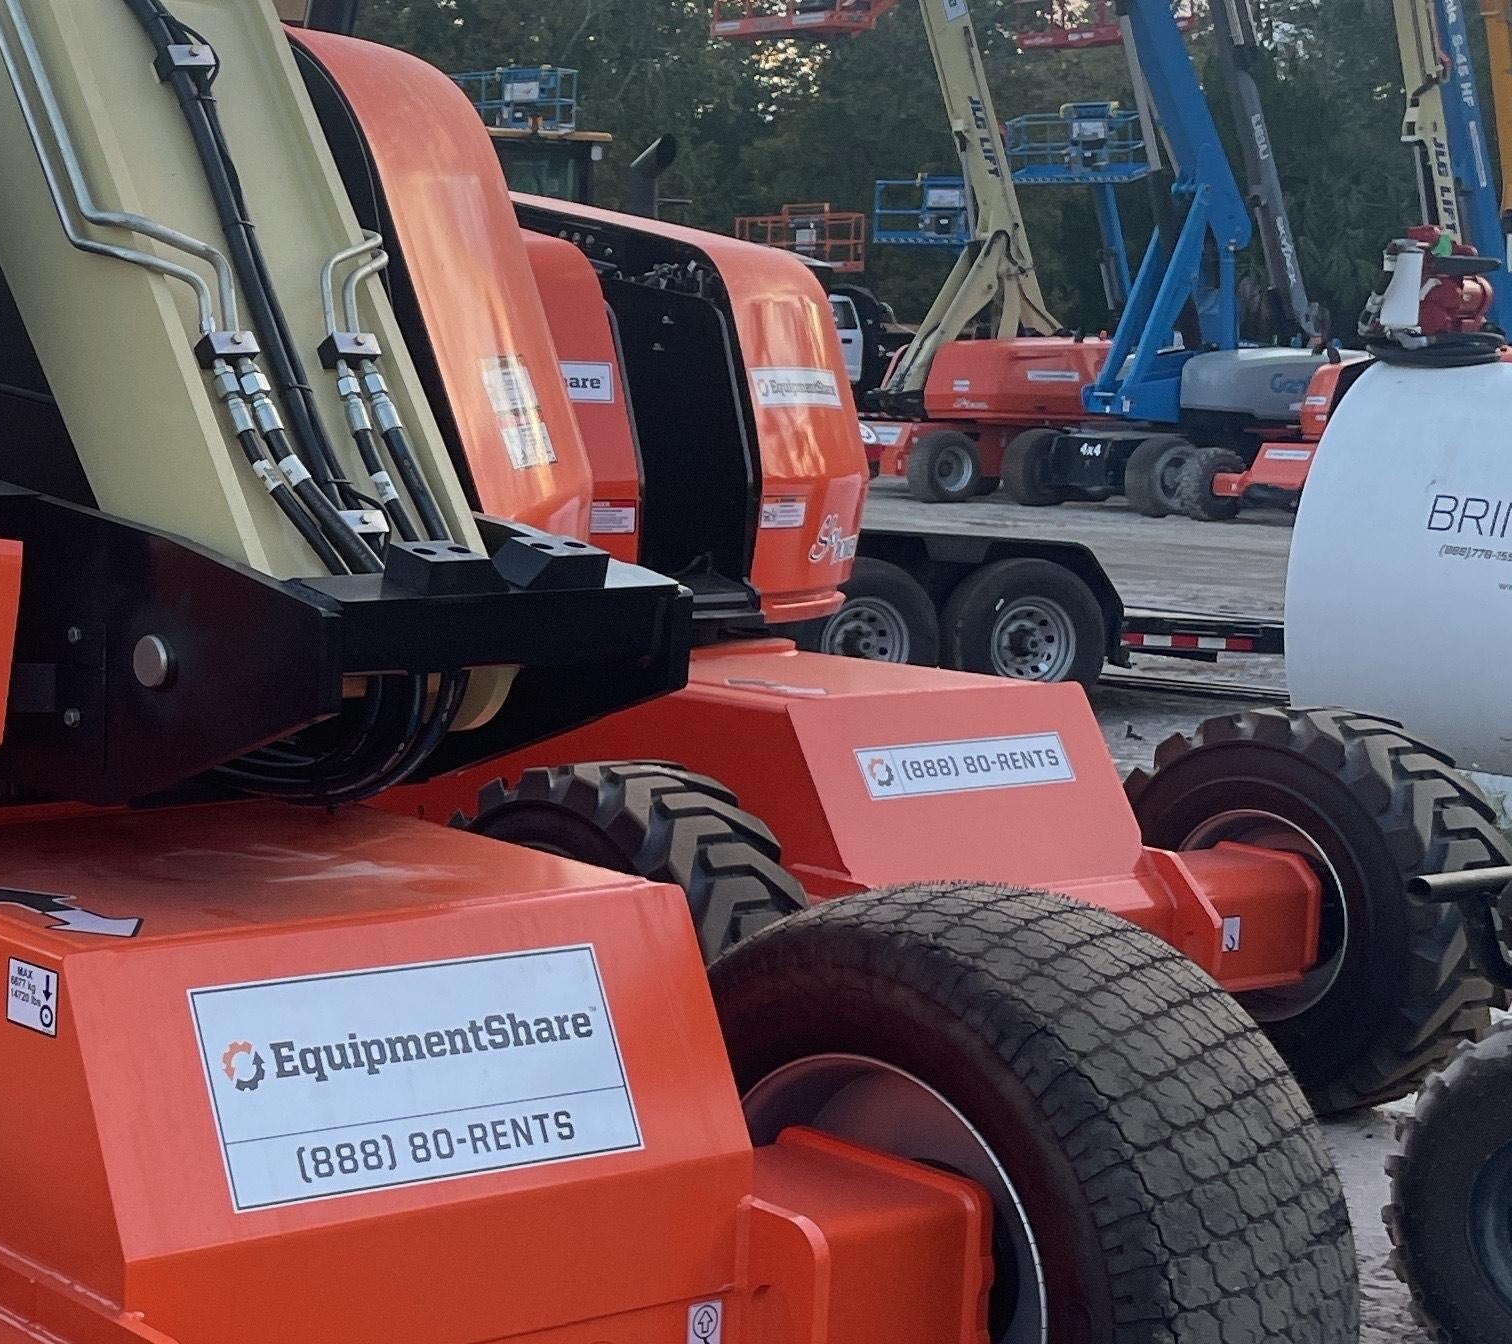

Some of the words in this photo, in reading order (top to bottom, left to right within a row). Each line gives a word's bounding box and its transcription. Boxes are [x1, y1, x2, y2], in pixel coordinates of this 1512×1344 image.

[1079, 442, 1102, 457] 4x4
[901, 755, 960, 781] (888)
[963, 748, 1060, 775] 80-RENTS
[17, 966, 34, 980] MAX
[269, 1009, 593, 1083] EquipmentShare
[296, 1133, 398, 1184] (888)
[408, 1110, 576, 1164] 80-RENTS
